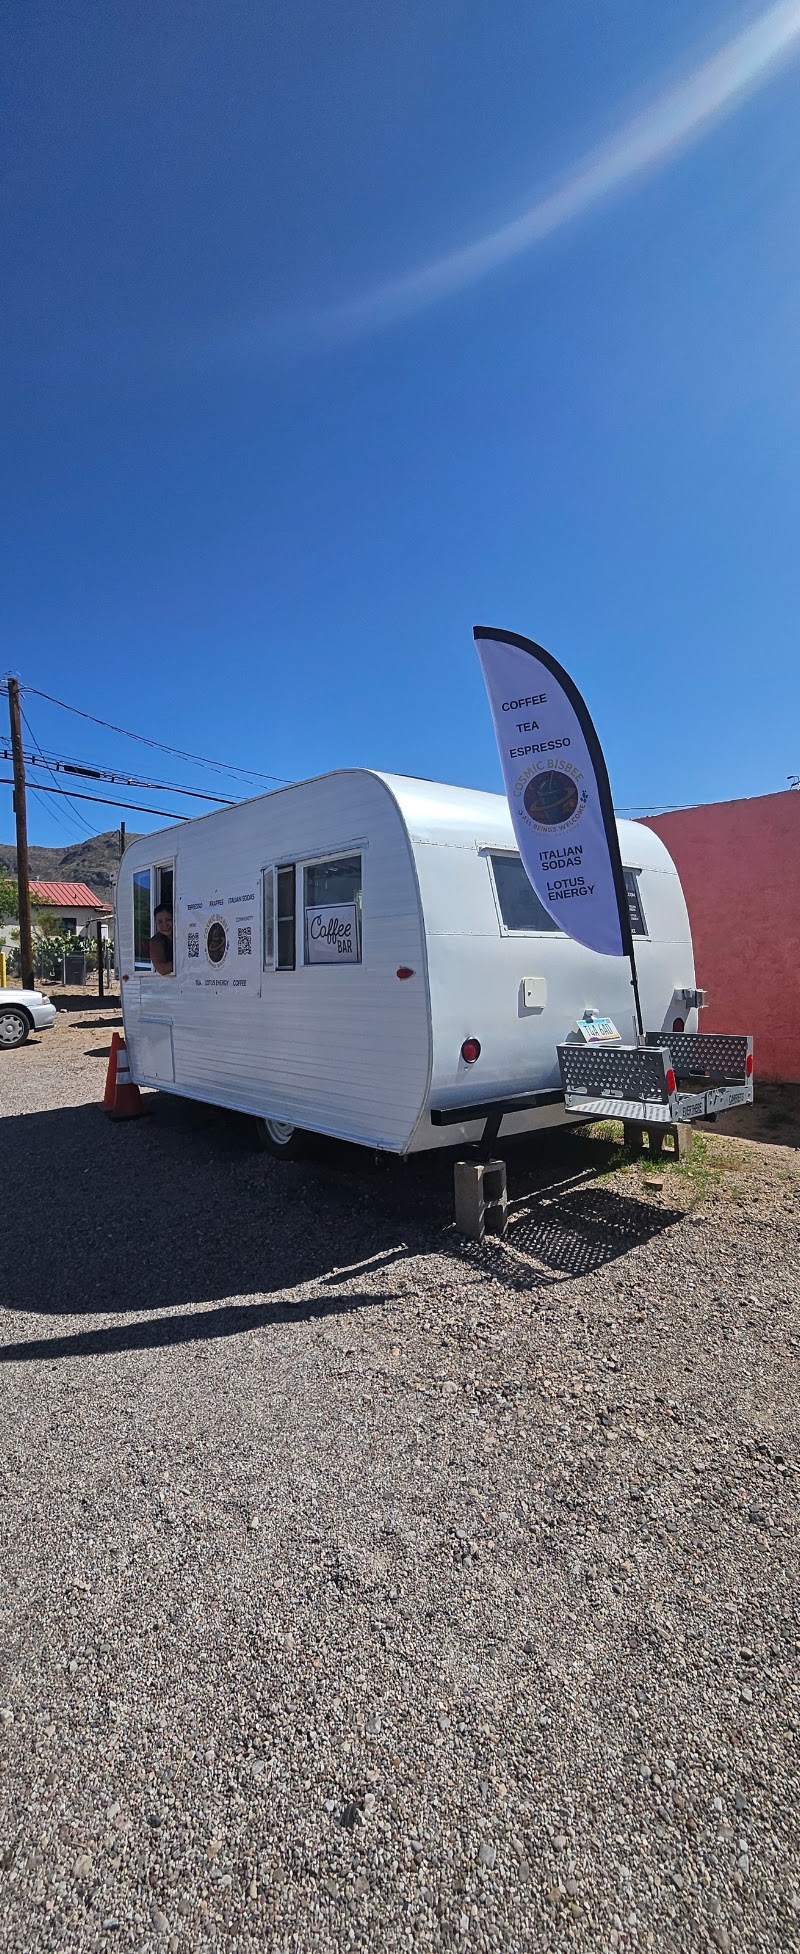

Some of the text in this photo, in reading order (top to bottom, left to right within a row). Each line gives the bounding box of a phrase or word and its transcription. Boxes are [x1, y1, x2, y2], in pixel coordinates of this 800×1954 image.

[502, 694, 547, 711] COFFEE
[516, 721, 539, 733] TEA
[509, 738, 571, 758] ESPRESSO
[513, 759, 584, 797] COSMIC BISBEE
[522, 815, 532, 827] ALL
[533, 824, 557, 833] BEINGS
[559, 804, 586, 831] WELCOME
[539, 845, 583, 861] ITALIAN
[541, 856, 582, 871] SODAS
[546, 877, 585, 891] LOTUS
[227, 893, 255, 904] ITALIAN SODAS
[548, 885, 595, 901] ENERGY
[310, 914, 351, 944] Coffee
[337, 940, 352, 953] BAR
